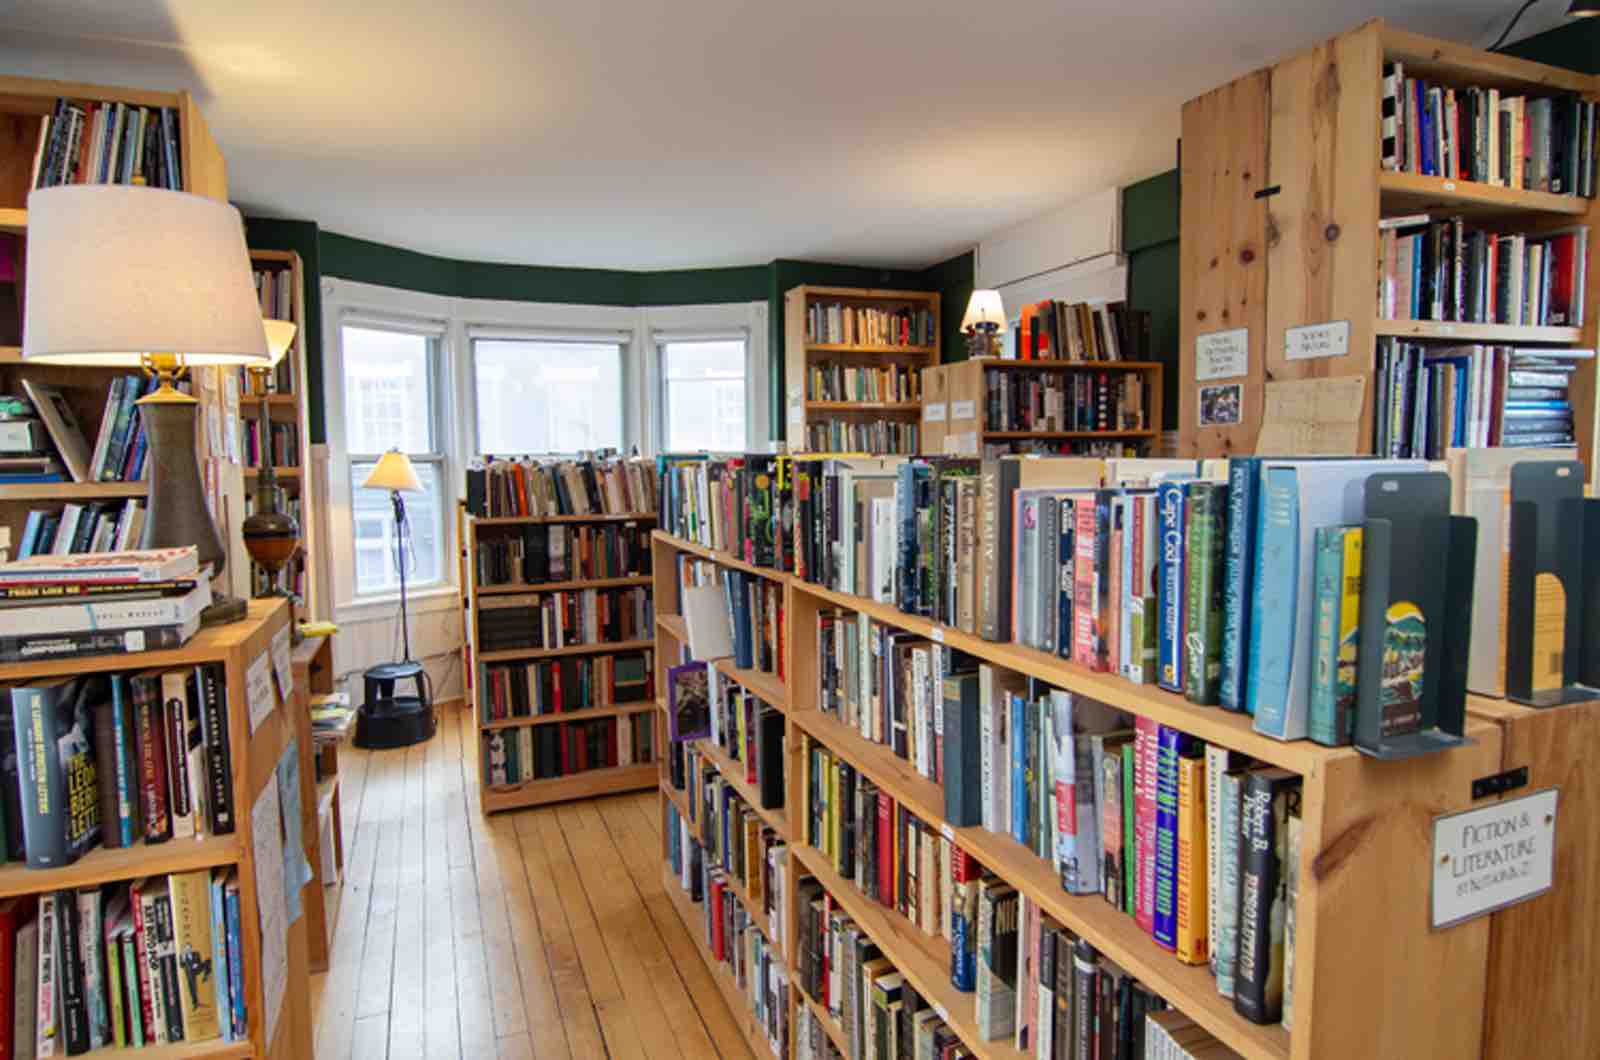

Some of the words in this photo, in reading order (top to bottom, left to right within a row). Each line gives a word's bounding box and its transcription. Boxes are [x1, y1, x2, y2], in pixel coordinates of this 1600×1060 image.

[983, 473, 995, 560] MALRAUX
[1161, 488, 1183, 530] Cape
[1165, 531, 1183, 562] Cod
[207, 678, 215, 704] MARK
[209, 708, 219, 747] MORRIS
[1135, 728, 1145, 797] Pamuk
[1144, 735, 1158, 801] Orhan
[1158, 747, 1177, 817] PASTIME
[1241, 793, 1254, 838] Parker
[1254, 789, 1270, 836] Robert
[1462, 816, 1518, 848] FICTION
[1518, 811, 1531, 829] &
[1252, 837, 1268, 852] B.
[1452, 837, 1537, 878] LITERATURE
[1144, 855, 1155, 915] Museum
[1156, 875, 1172, 917] PARKER
[1240, 873, 1258, 982] RESOLUTION
